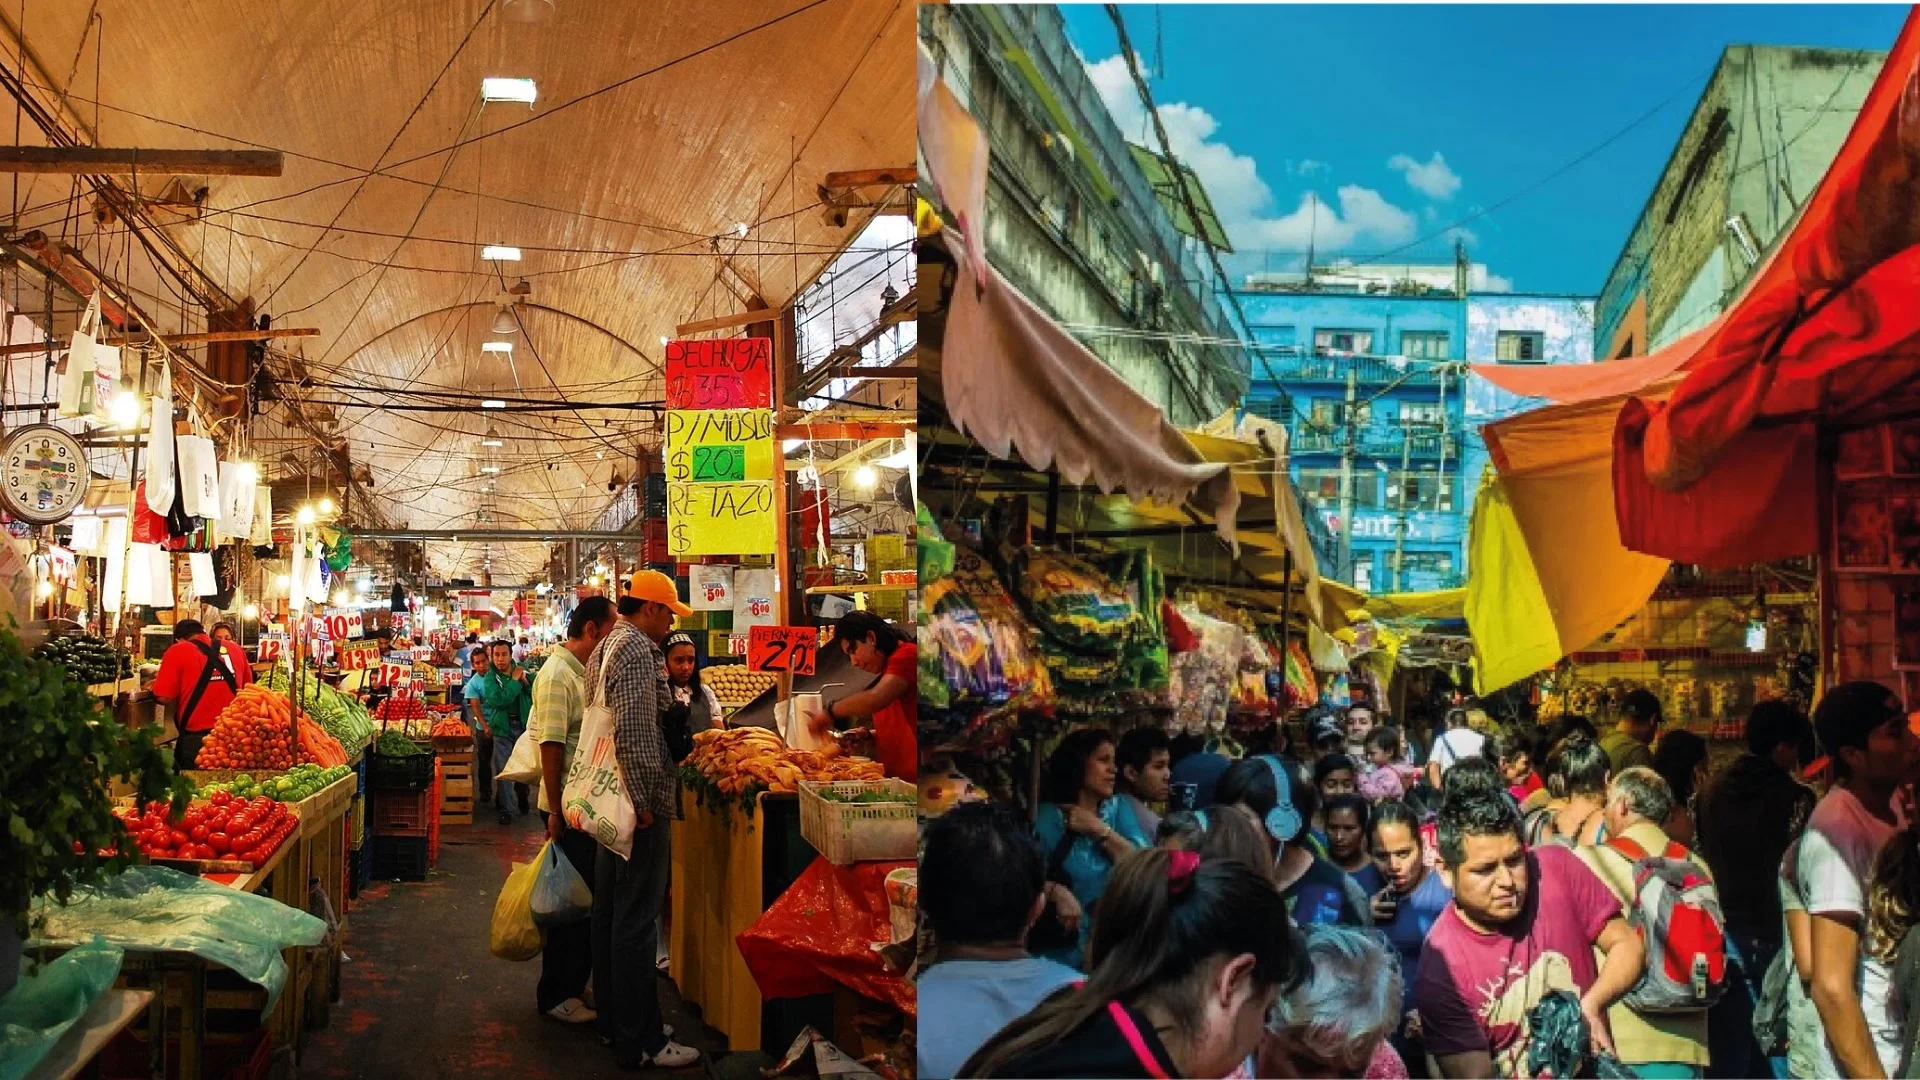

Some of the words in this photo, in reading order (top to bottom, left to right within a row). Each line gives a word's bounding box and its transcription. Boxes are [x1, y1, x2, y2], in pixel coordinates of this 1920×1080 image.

[25, 444, 30, 453] 1
[42, 440, 50, 449] 0
[58, 447, 66, 457] 9
[12, 457, 20, 467] 2
[68, 463, 76, 473] 8
[11, 477, 19, 487] 3
[69, 482, 76, 492] 7
[20, 492, 28, 502] 4
[38, 500, 46, 510] 5
